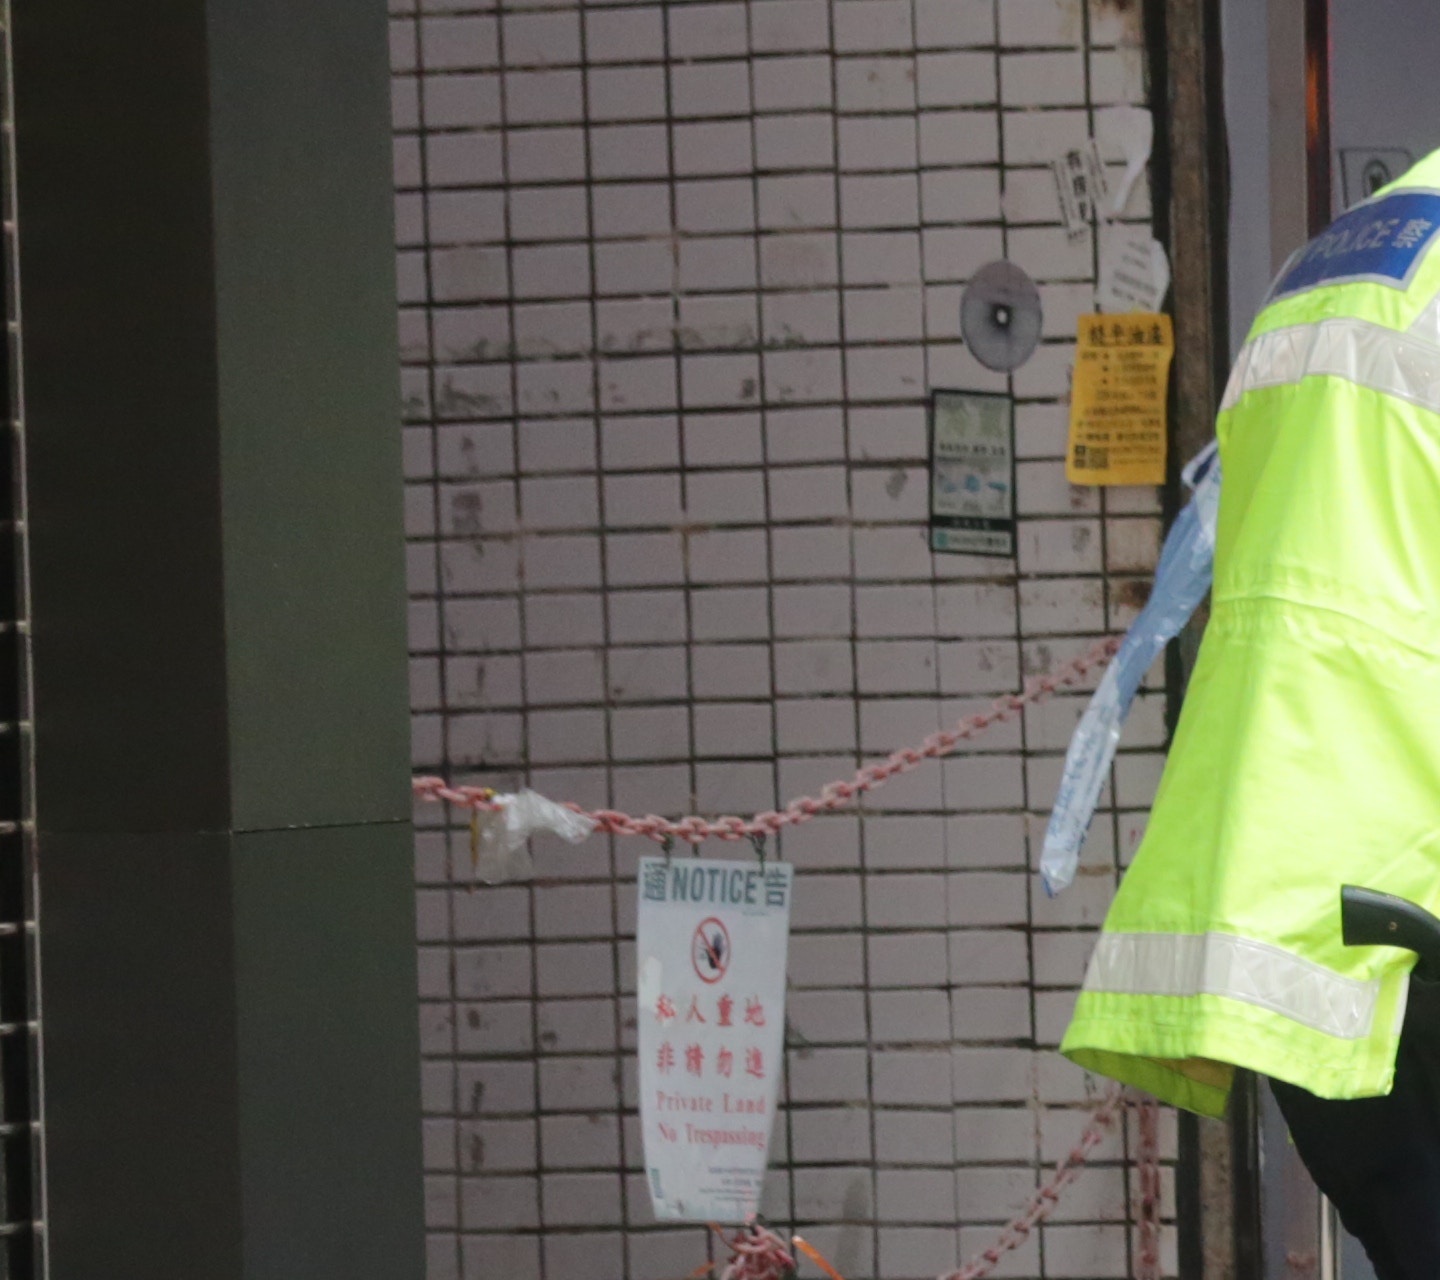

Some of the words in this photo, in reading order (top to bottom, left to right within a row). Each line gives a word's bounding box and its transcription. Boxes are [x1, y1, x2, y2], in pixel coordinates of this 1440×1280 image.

[671, 866, 758, 905] NOTICE
[765, 867, 788, 907] 告
[655, 993, 767, 1028] 私人重地
[655, 1041, 767, 1080] 非請勿進
[656, 1090, 715, 1114] Private
[722, 1091, 767, 1116] Land
[657, 1121, 678, 1144] No
[685, 1122, 767, 1150] Trespassing
